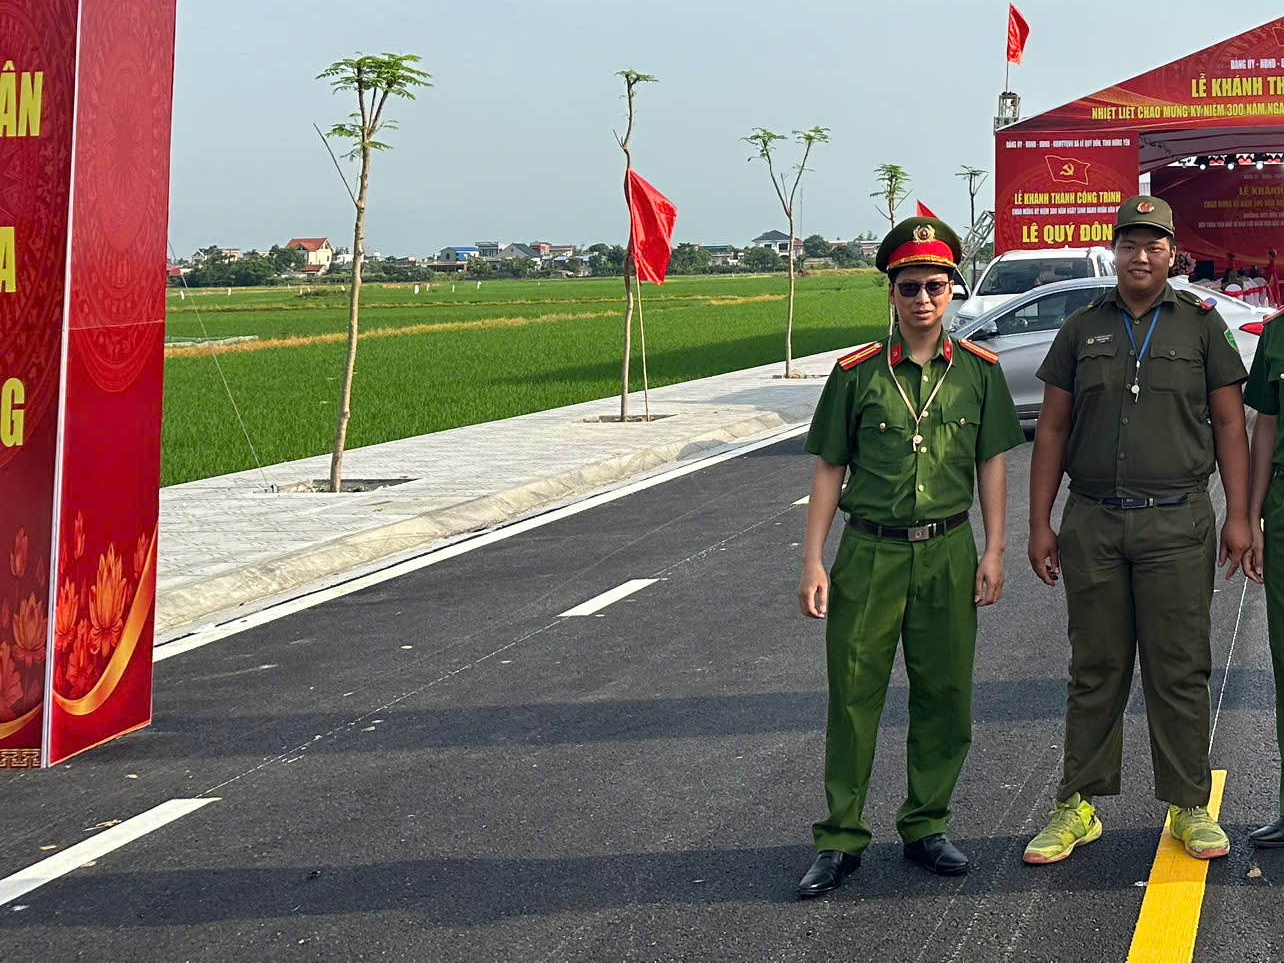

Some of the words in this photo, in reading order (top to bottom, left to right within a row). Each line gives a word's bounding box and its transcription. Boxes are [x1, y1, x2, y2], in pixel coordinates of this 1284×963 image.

[1192, 73, 1206, 97] LỄ
[1212, 75, 1262, 96] KHÁNH
[0, 61, 43, 137] ÂN
[1227, 103, 1244, 116] 300
[1022, 222, 1038, 243] LÊ
[1044, 222, 1076, 244] QUÝ
[1080, 221, 1113, 242] ĐÔN
